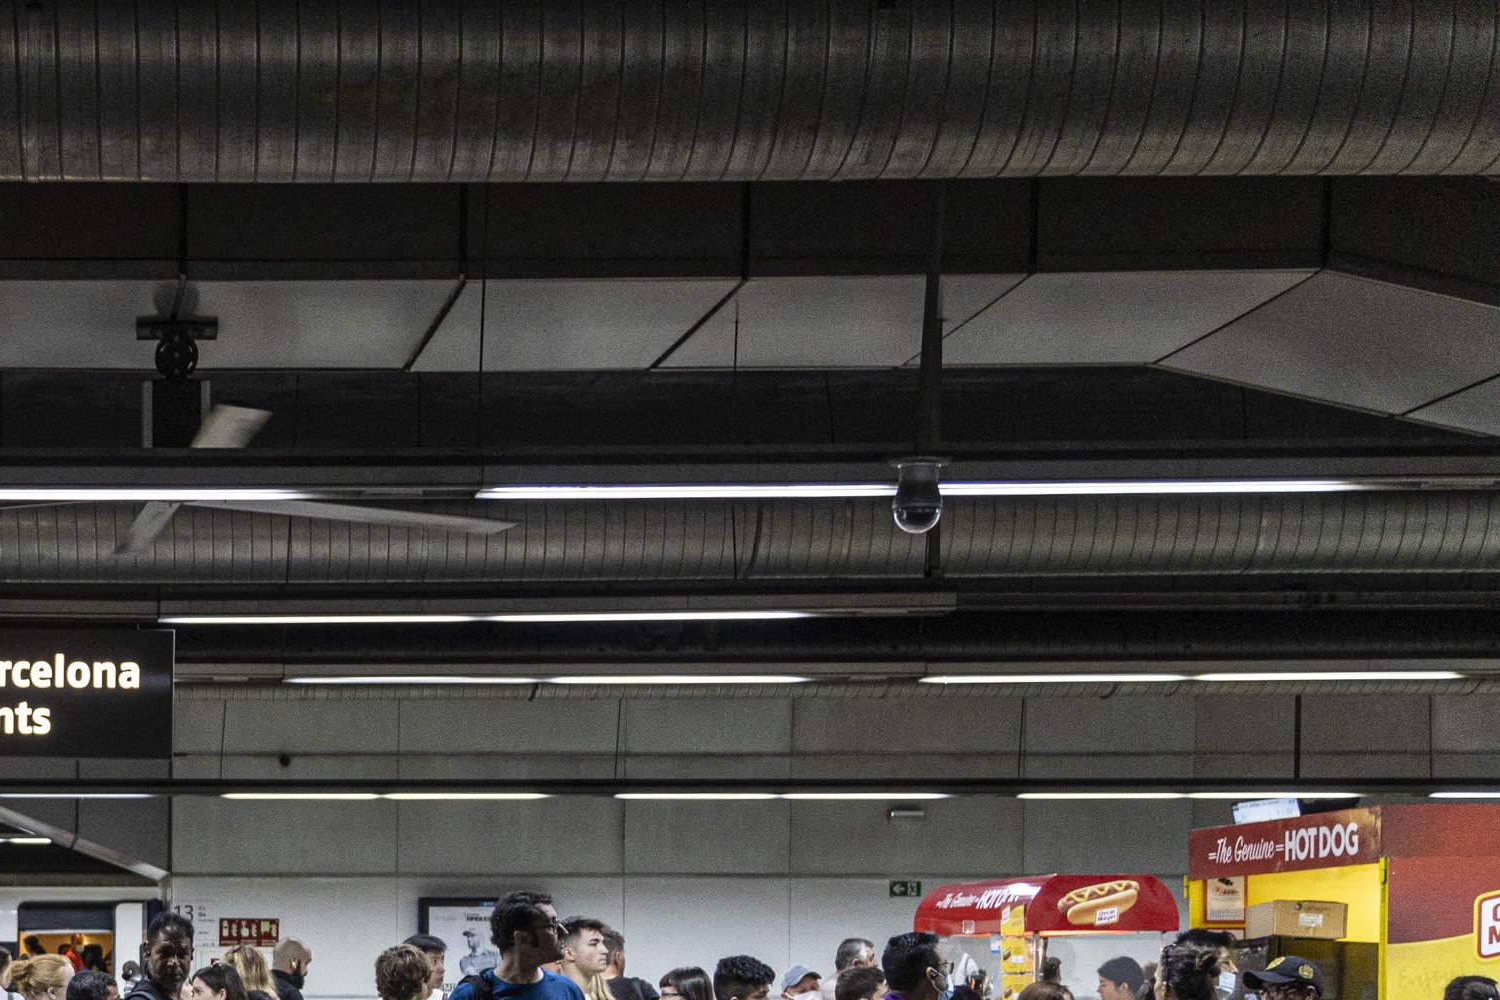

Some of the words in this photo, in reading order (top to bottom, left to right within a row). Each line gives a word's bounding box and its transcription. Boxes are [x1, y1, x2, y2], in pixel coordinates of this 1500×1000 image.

[1215, 837, 1233, 864] The
[1234, 835, 1275, 863] Genuine
[174, 904, 194, 922] 13
